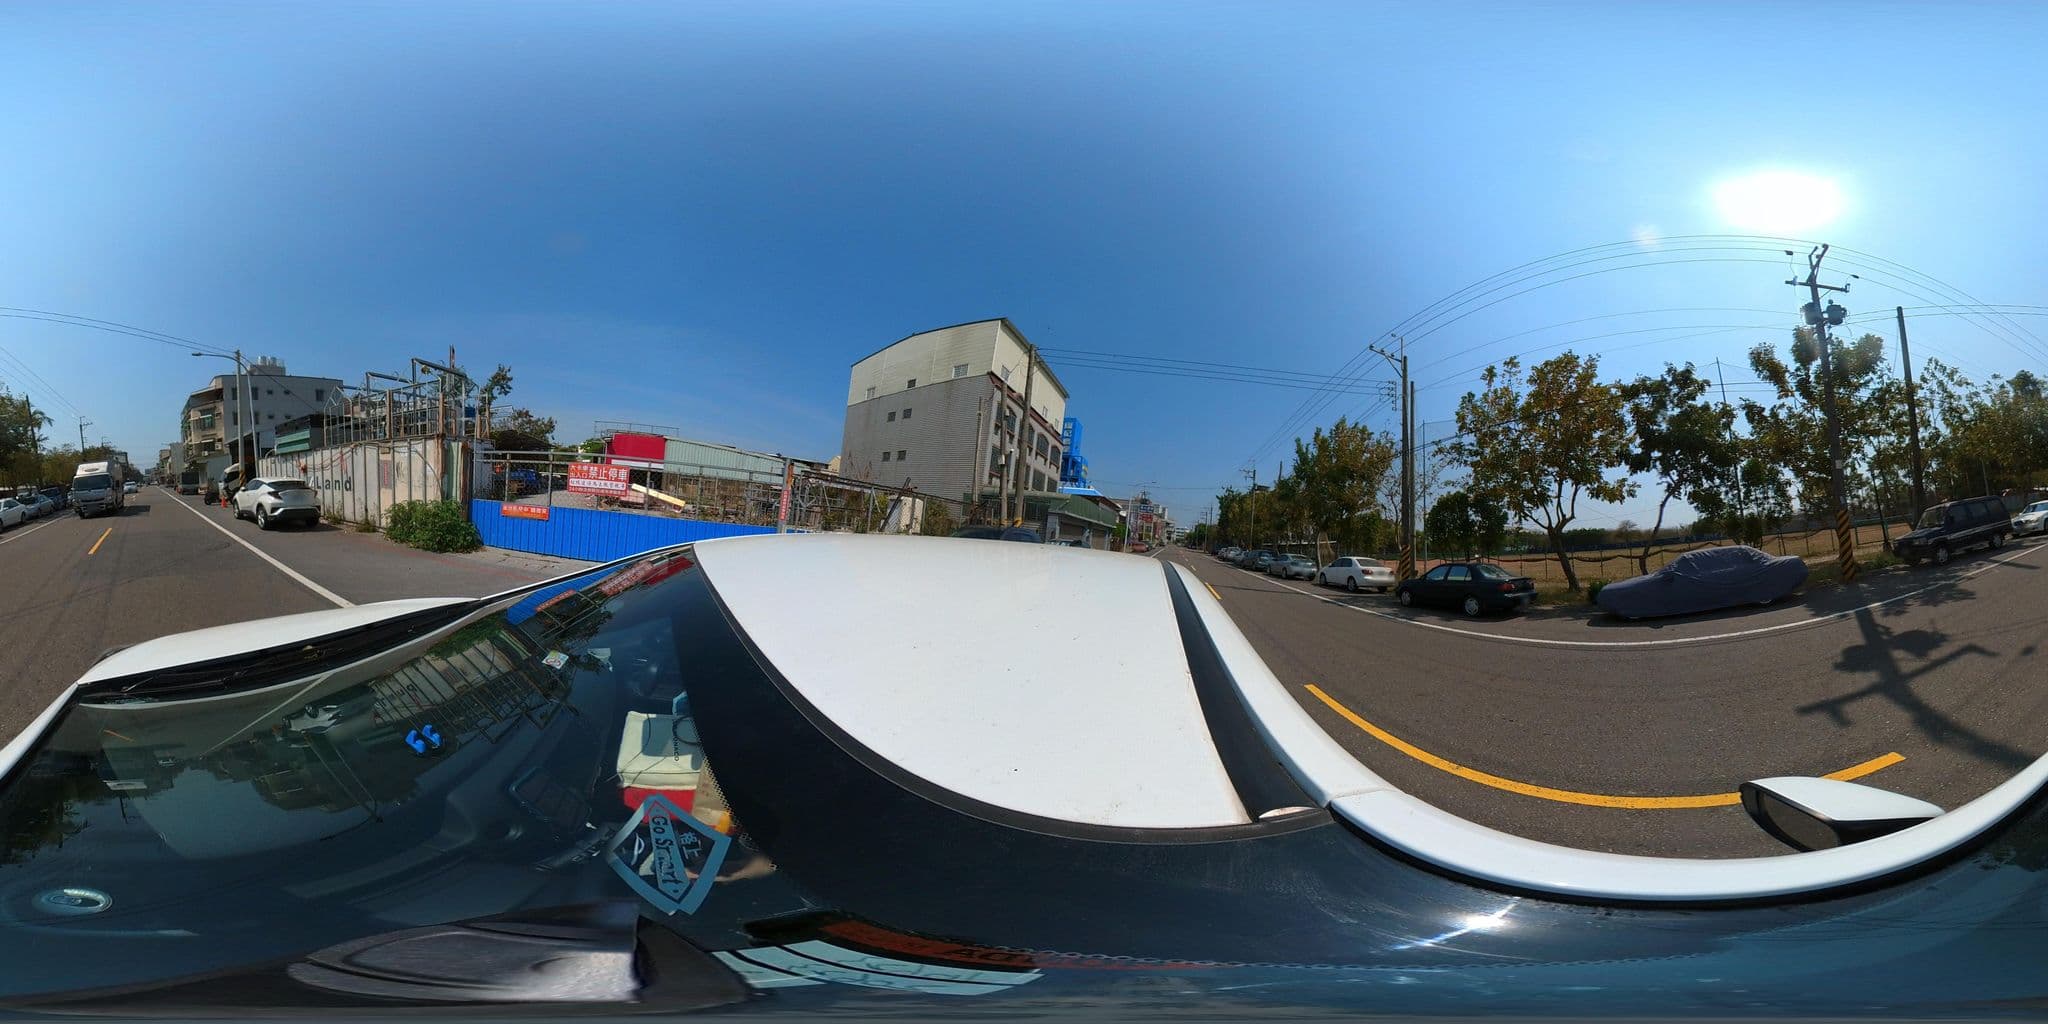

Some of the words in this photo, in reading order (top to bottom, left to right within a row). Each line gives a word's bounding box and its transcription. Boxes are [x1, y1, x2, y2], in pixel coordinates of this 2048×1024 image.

[589, 466, 628, 481] 禁止停車
[316, 476, 352, 492] Land
[651, 815, 668, 834] Go
